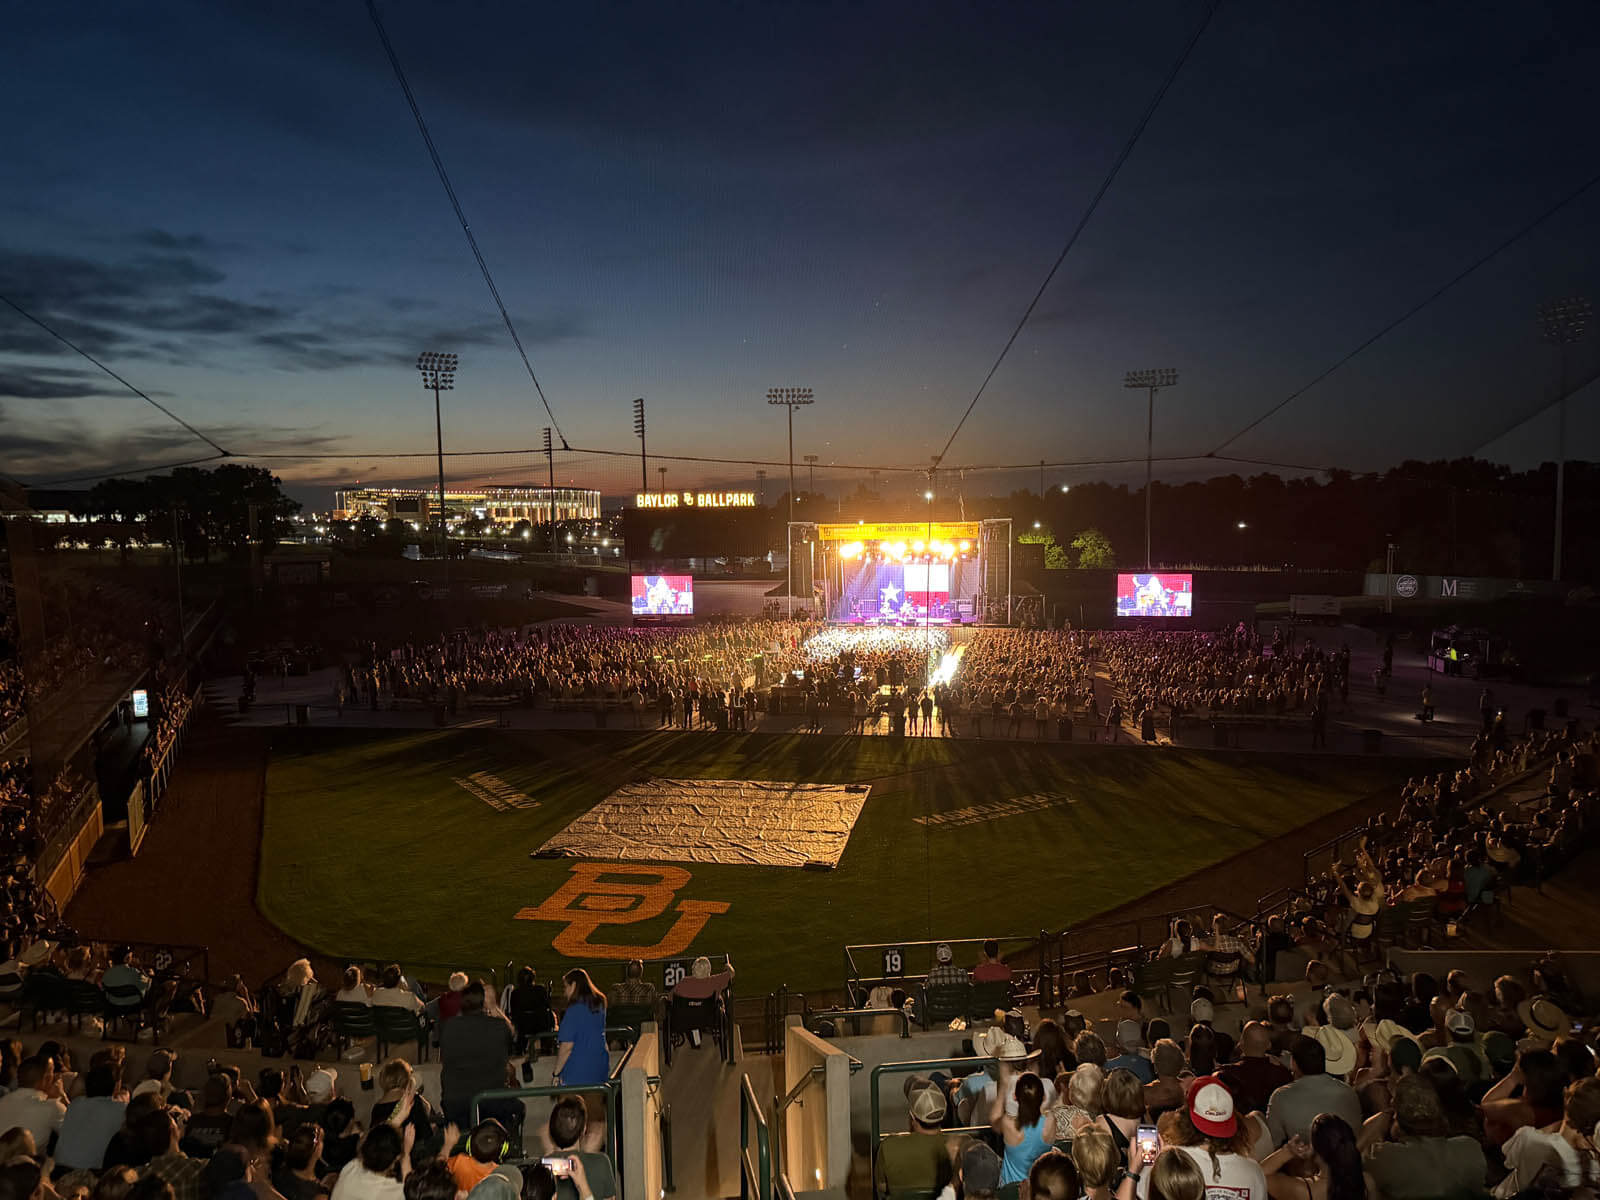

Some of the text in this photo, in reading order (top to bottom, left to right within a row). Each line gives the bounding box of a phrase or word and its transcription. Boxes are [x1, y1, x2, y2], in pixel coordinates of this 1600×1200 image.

[636, 493, 679, 508] BAYLOR
[697, 493, 756, 507] BALLPARK
[1440, 578, 1457, 597] M
[512, 862, 733, 960] BU
[885, 954, 902, 973] 19
[664, 967, 686, 986] 20
